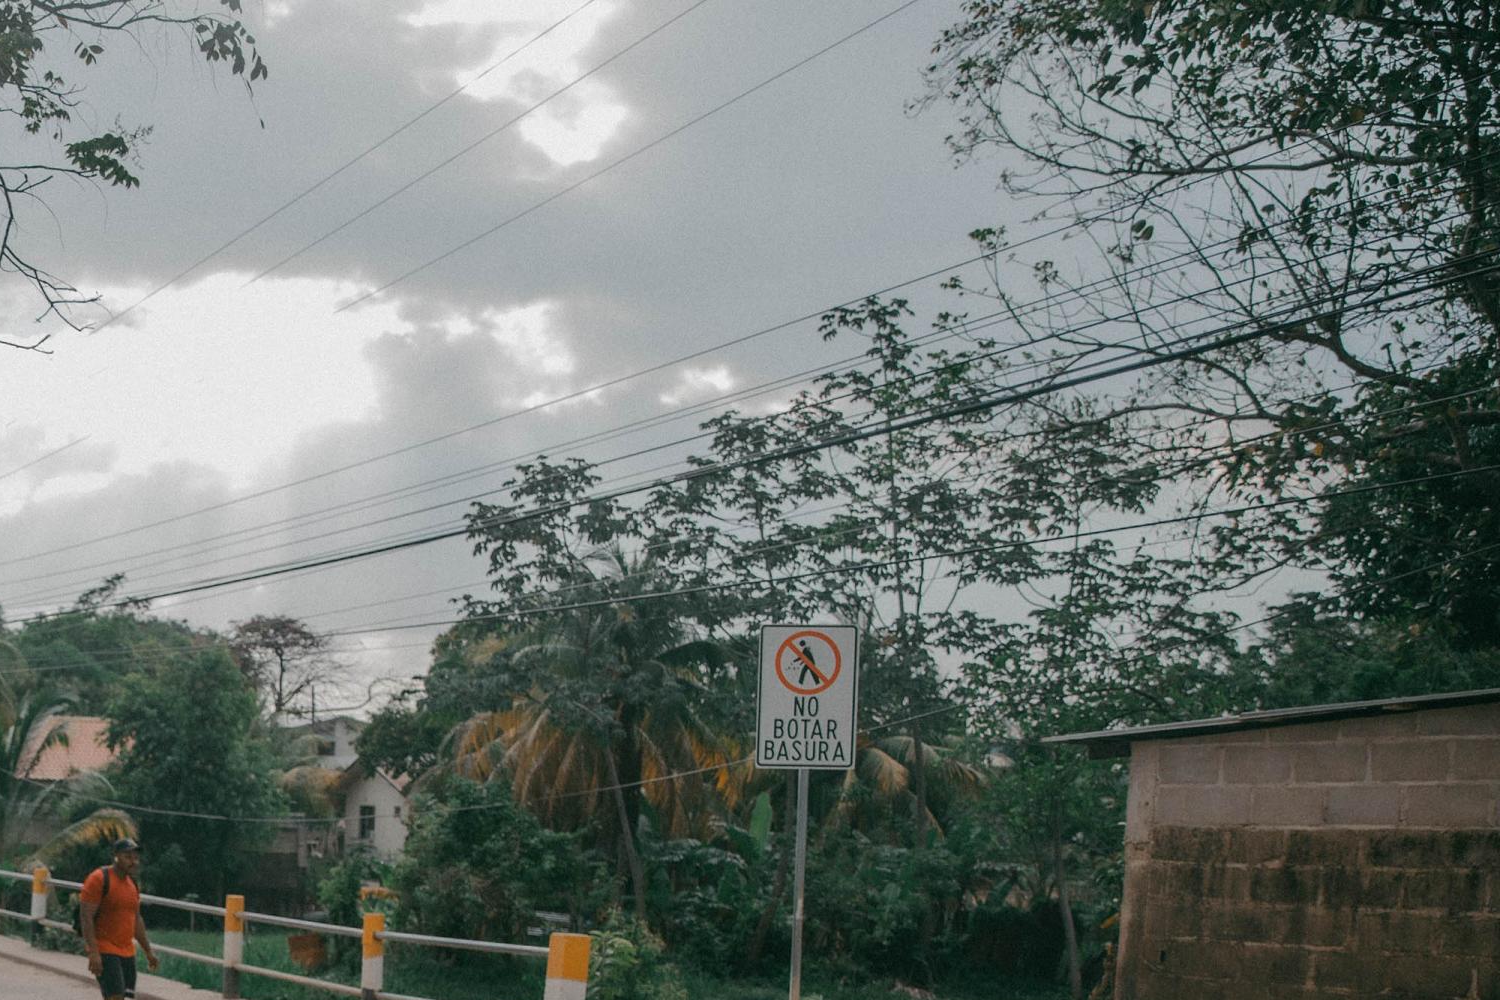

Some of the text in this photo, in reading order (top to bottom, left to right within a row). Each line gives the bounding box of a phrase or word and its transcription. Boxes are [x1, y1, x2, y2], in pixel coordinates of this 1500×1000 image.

[793, 696, 819, 717] NO
[773, 718, 838, 740] BOTAR
[764, 740, 845, 762] BASURA
